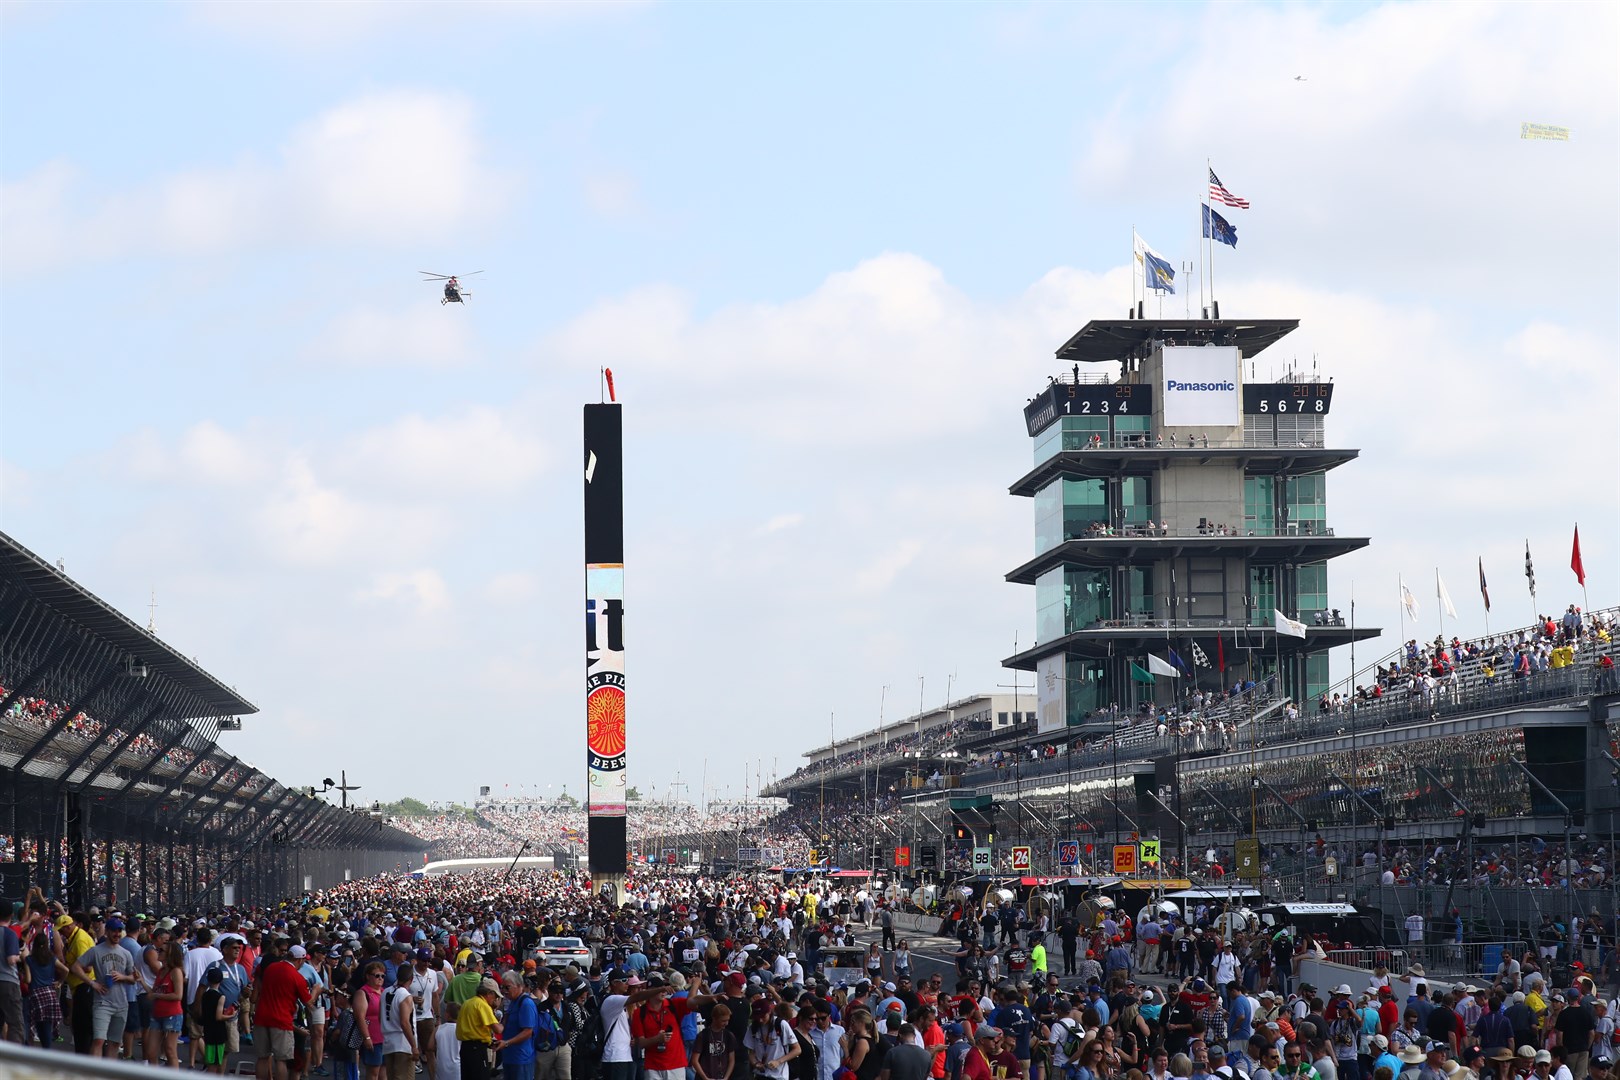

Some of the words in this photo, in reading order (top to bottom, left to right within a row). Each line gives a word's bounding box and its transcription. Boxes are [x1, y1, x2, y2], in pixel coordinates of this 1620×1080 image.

[1167, 380, 1235, 392] Panasonic
[592, 757, 626, 769] BEER
[1061, 845, 1077, 863] 29
[1144, 845, 1156, 857] 21
[975, 853, 989, 864] 98
[1014, 850, 1028, 865] 26
[1116, 851, 1133, 867] 28
[1243, 856, 1251, 867] 5
[1327, 864, 1335, 874] 5
[1181, 943, 1188, 953] 5
[606, 950, 613, 961] 5
